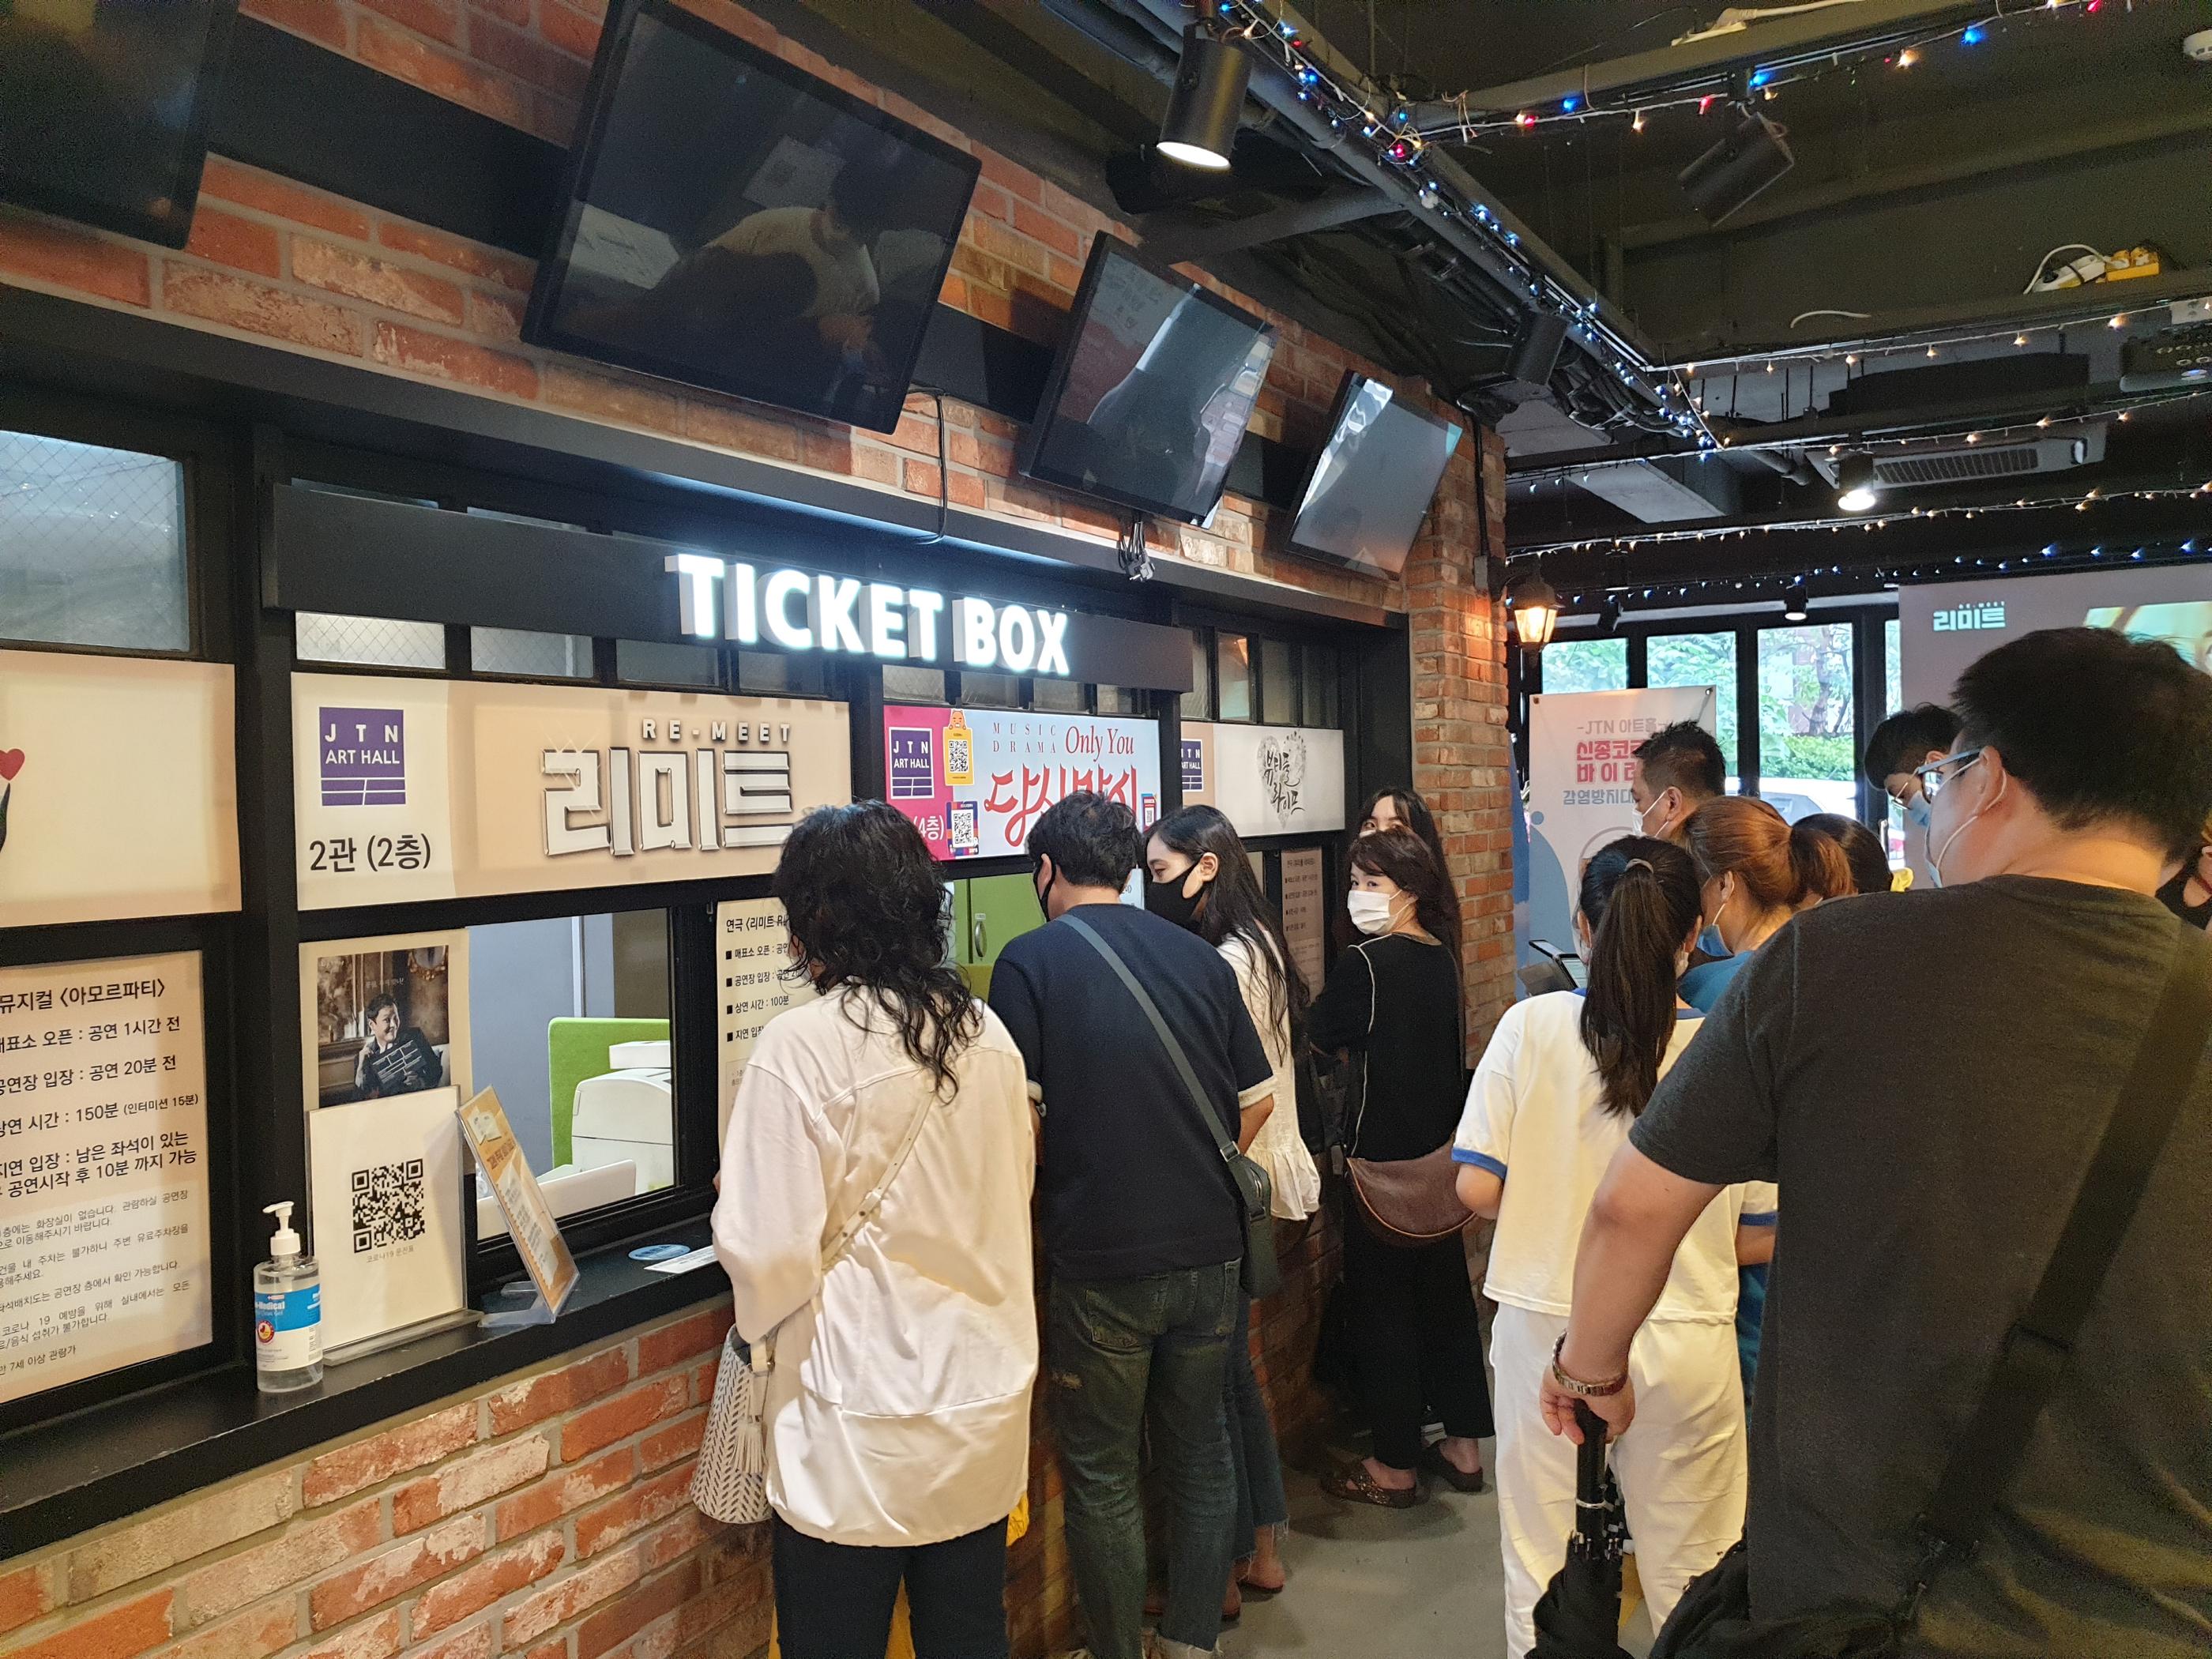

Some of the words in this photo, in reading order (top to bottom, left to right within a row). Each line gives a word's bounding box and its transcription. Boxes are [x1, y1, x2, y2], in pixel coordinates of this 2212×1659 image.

[666, 553, 945, 662] TICKET
[952, 596, 1071, 676] BOX
[1933, 608, 2006, 631] 리미트
[992, 722, 1057, 736] MUSIC
[992, 741, 1057, 753] DRAMA
[1066, 725, 1104, 763] Only
[1107, 728, 1135, 755] You
[325, 750, 356, 765] ART
[360, 749, 401, 764] HALL
[893, 758, 908, 769] ART
[909, 758, 930, 769] HALL
[542, 747, 793, 856] 리미트
[1270, 783, 1306, 814] 라이프
[309, 836, 357, 872] 2관
[367, 833, 431, 871] (2층)
[726, 918, 743, 933] 연극
[735, 946, 755, 959] 매표소
[757, 946, 769, 957] 오픈
[735, 974, 755, 987] 공연장
[757, 972, 770, 984] 입장
[0, 990, 52, 1014] 뮤지컬
[735, 1002, 749, 1014] 상연
[750, 999, 765, 1011] 시간
[771, 995, 789, 1007] 100분
[43, 1029, 73, 1046] 오픈
[88, 1023, 118, 1041] 공연
[124, 1018, 161, 1036] 1시간
[166, 1016, 180, 1031] 전
[735, 1028, 749, 1040] 지연
[43, 1069, 73, 1088] 입장
[88, 1063, 118, 1082] 공연
[124, 1057, 157, 1075] 20분
[162, 1055, 177, 1070] 전
[28, 1112, 59, 1130] 시간
[76, 1103, 119, 1122] 150분
[123, 1097, 169, 1115] (인터미션
[172, 1093, 199, 1108] 15분)
[29, 1153, 60, 1172] 입장
[77, 1144, 106, 1164] 남은
[111, 1135, 155, 1157] 좌석이
[160, 1131, 189, 1149] 있는
[8, 1171, 70, 1198] 공연시작
[75, 1168, 90, 1183] 후
[96, 1161, 130, 1179] 10분
[134, 1153, 163, 1172] 까지
[169, 1149, 197, 1165] 가능
[36, 1213, 72, 1228] 화장실이
[163, 1190, 188, 1203] 공연장
[54, 1284, 81, 1299] 공연장
[2, 1321, 29, 1337] 코로나
[40, 1315, 51, 1326] 19
[173, 1280, 190, 1292] 모든
[9, 1360, 24, 1371] 7세
[28, 1353, 46, 1365] 이상
